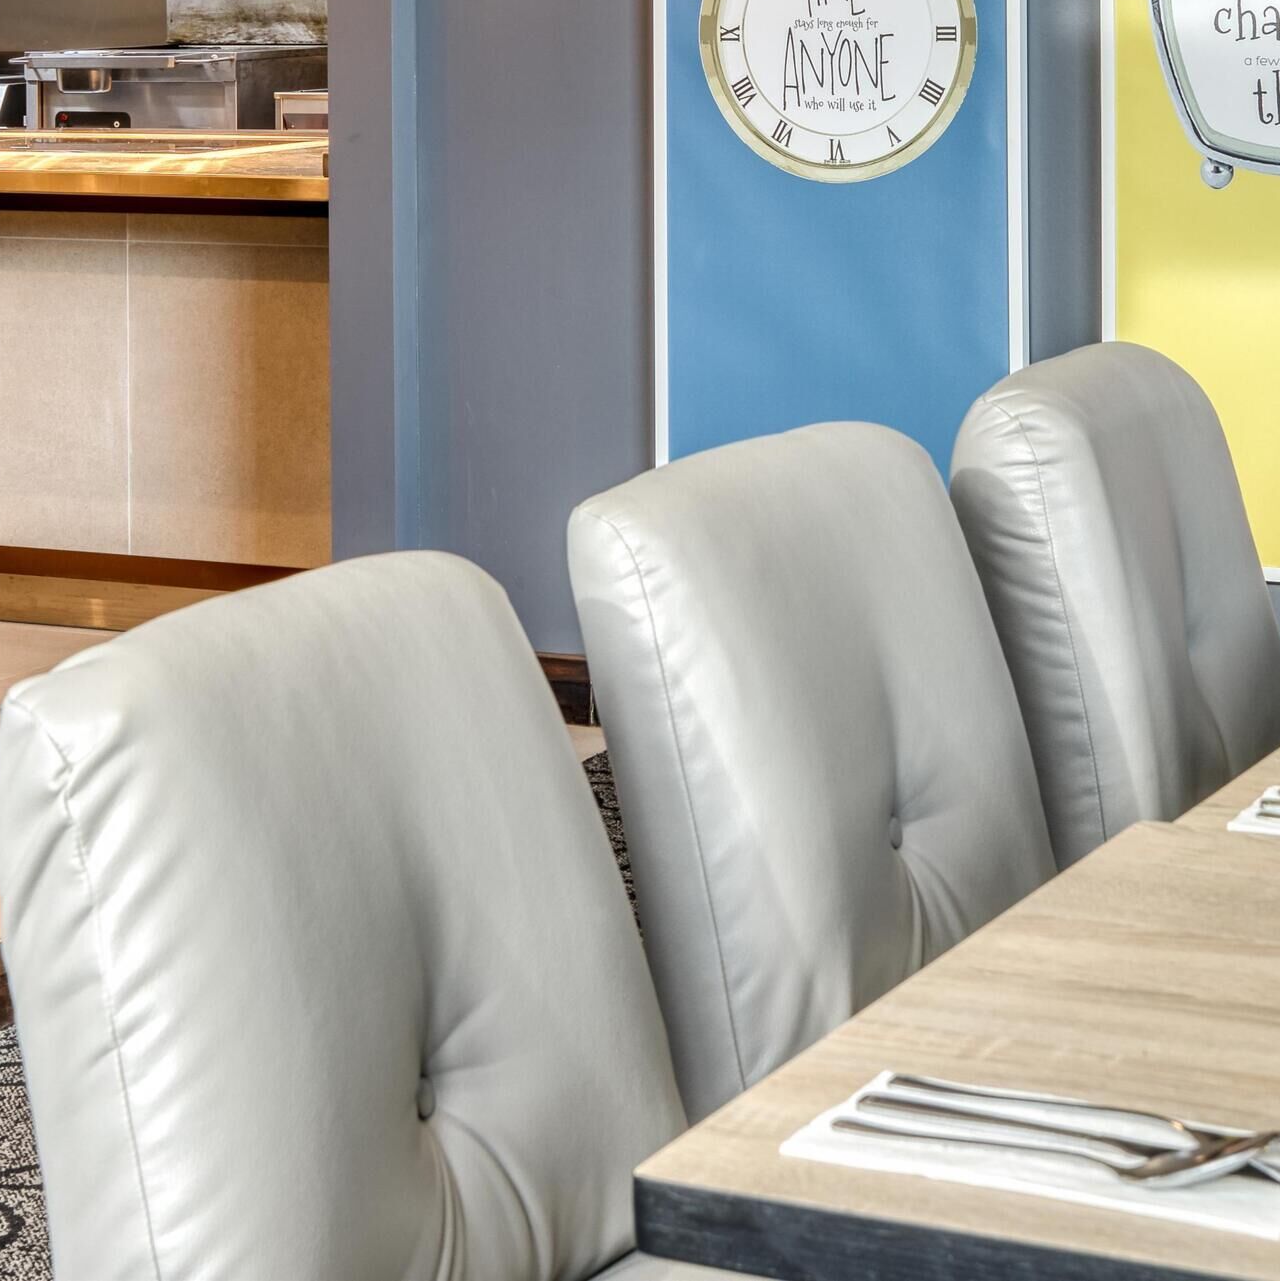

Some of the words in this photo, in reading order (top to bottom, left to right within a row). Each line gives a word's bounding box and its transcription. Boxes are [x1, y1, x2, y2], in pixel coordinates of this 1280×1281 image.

[794, 18, 814, 29] stays
[817, 18, 833, 31] long
[836, 17, 863, 32] enough
[866, 17, 879, 30] for
[935, 26, 957, 42] III
[1244, 57, 1252, 66] a
[1256, 56, 1280, 66] few
[783, 27, 896, 111] ANYONE
[804, 97, 824, 111] who
[827, 98, 845, 112] will
[849, 100, 865, 112] use
[868, 99, 877, 111] it
